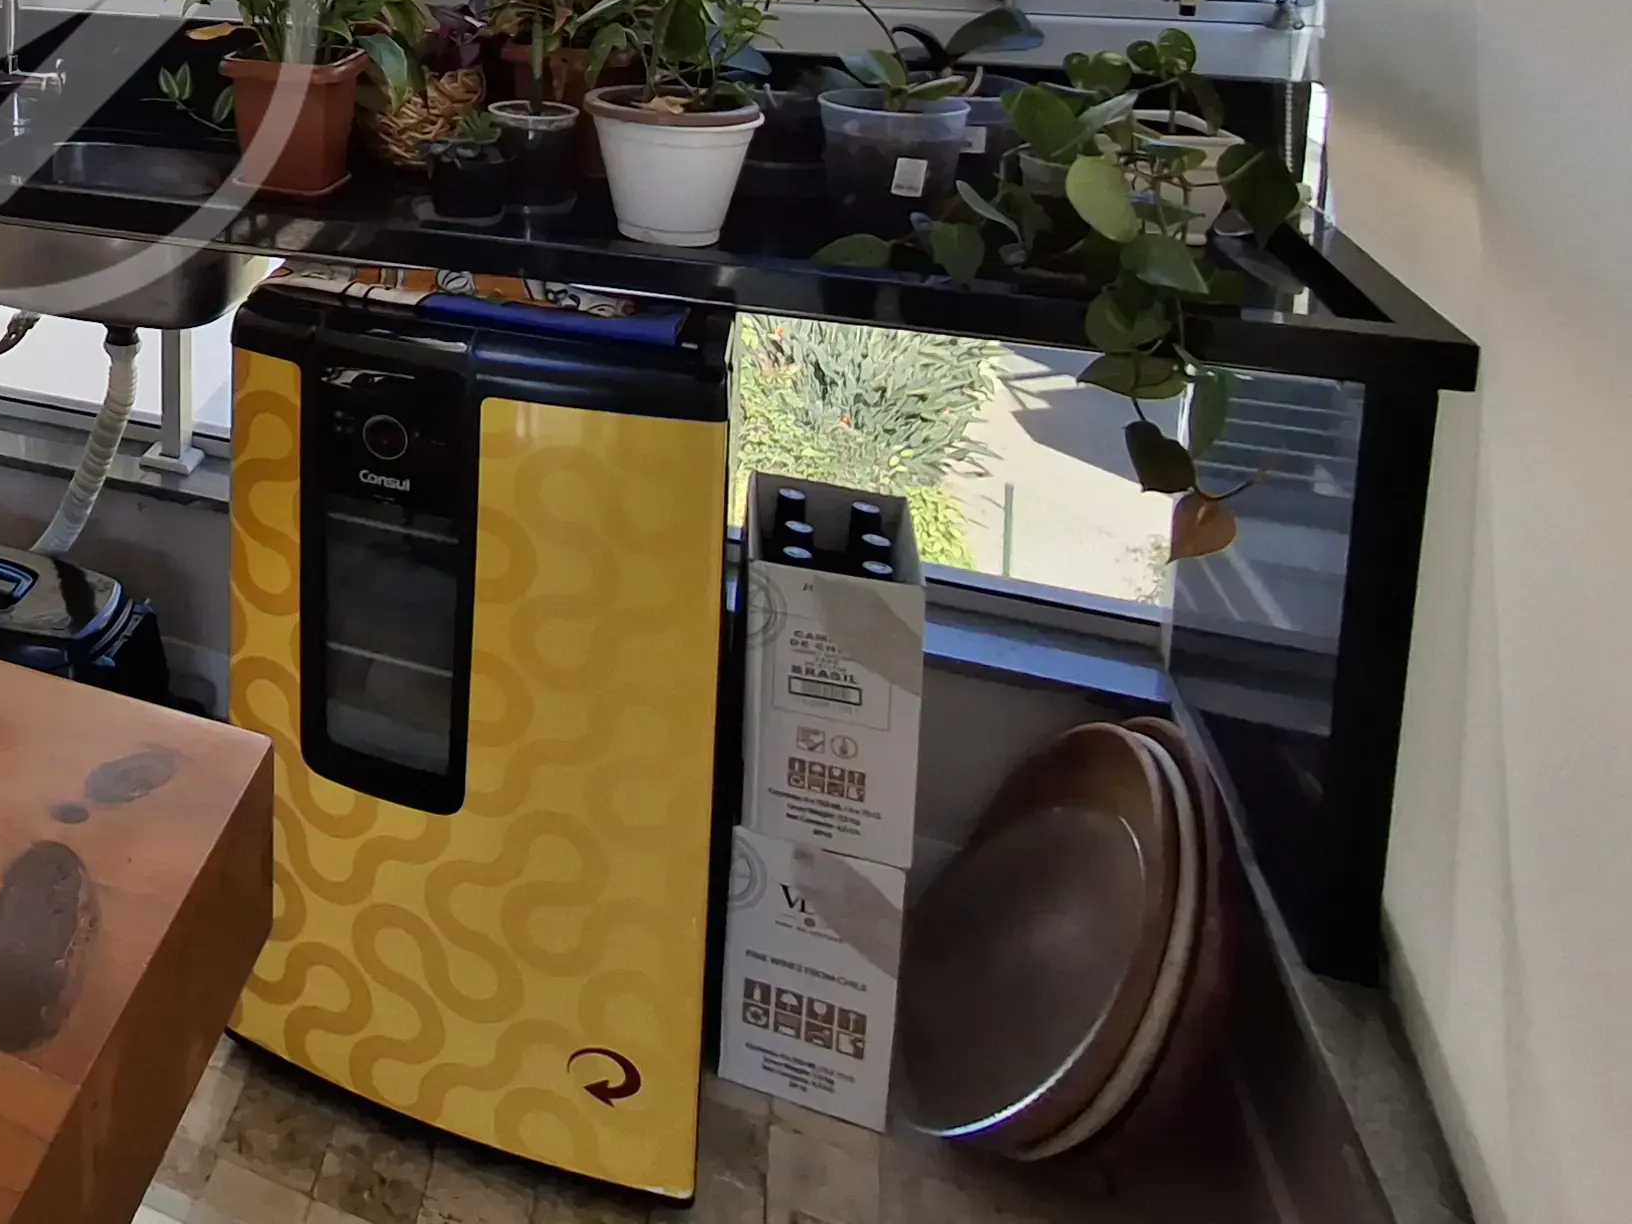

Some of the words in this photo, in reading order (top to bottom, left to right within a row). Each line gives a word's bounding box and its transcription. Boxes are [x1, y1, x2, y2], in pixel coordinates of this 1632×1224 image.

[358, 468, 411, 492] Consul
[793, 629, 829, 643] CAM
[814, 641, 841, 654] CH
[791, 664, 858, 684] BRASIL
